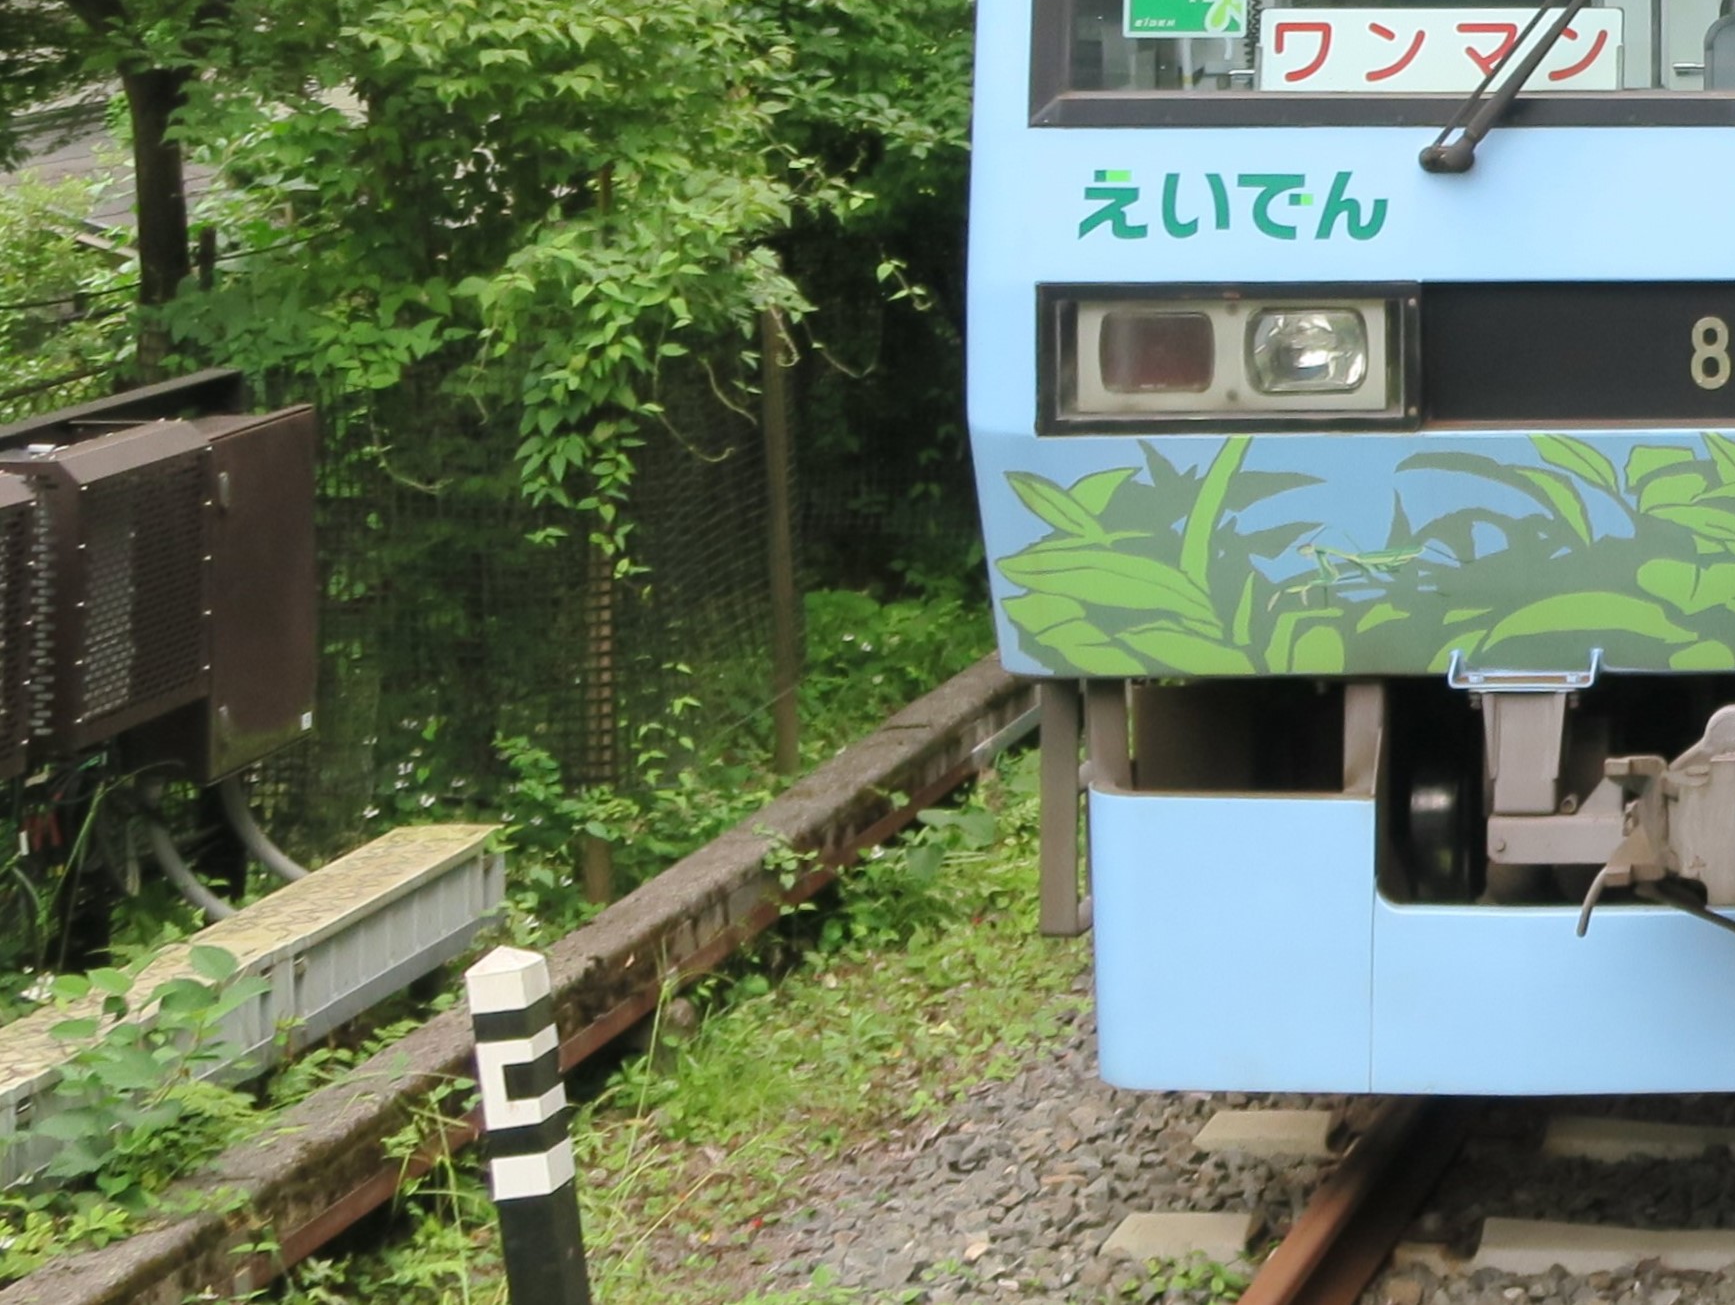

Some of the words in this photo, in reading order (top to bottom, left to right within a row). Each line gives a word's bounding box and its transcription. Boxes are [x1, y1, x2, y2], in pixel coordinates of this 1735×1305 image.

[1274, 22, 1608, 82] ワンマン
[1078, 170, 1389, 240] えいでん
